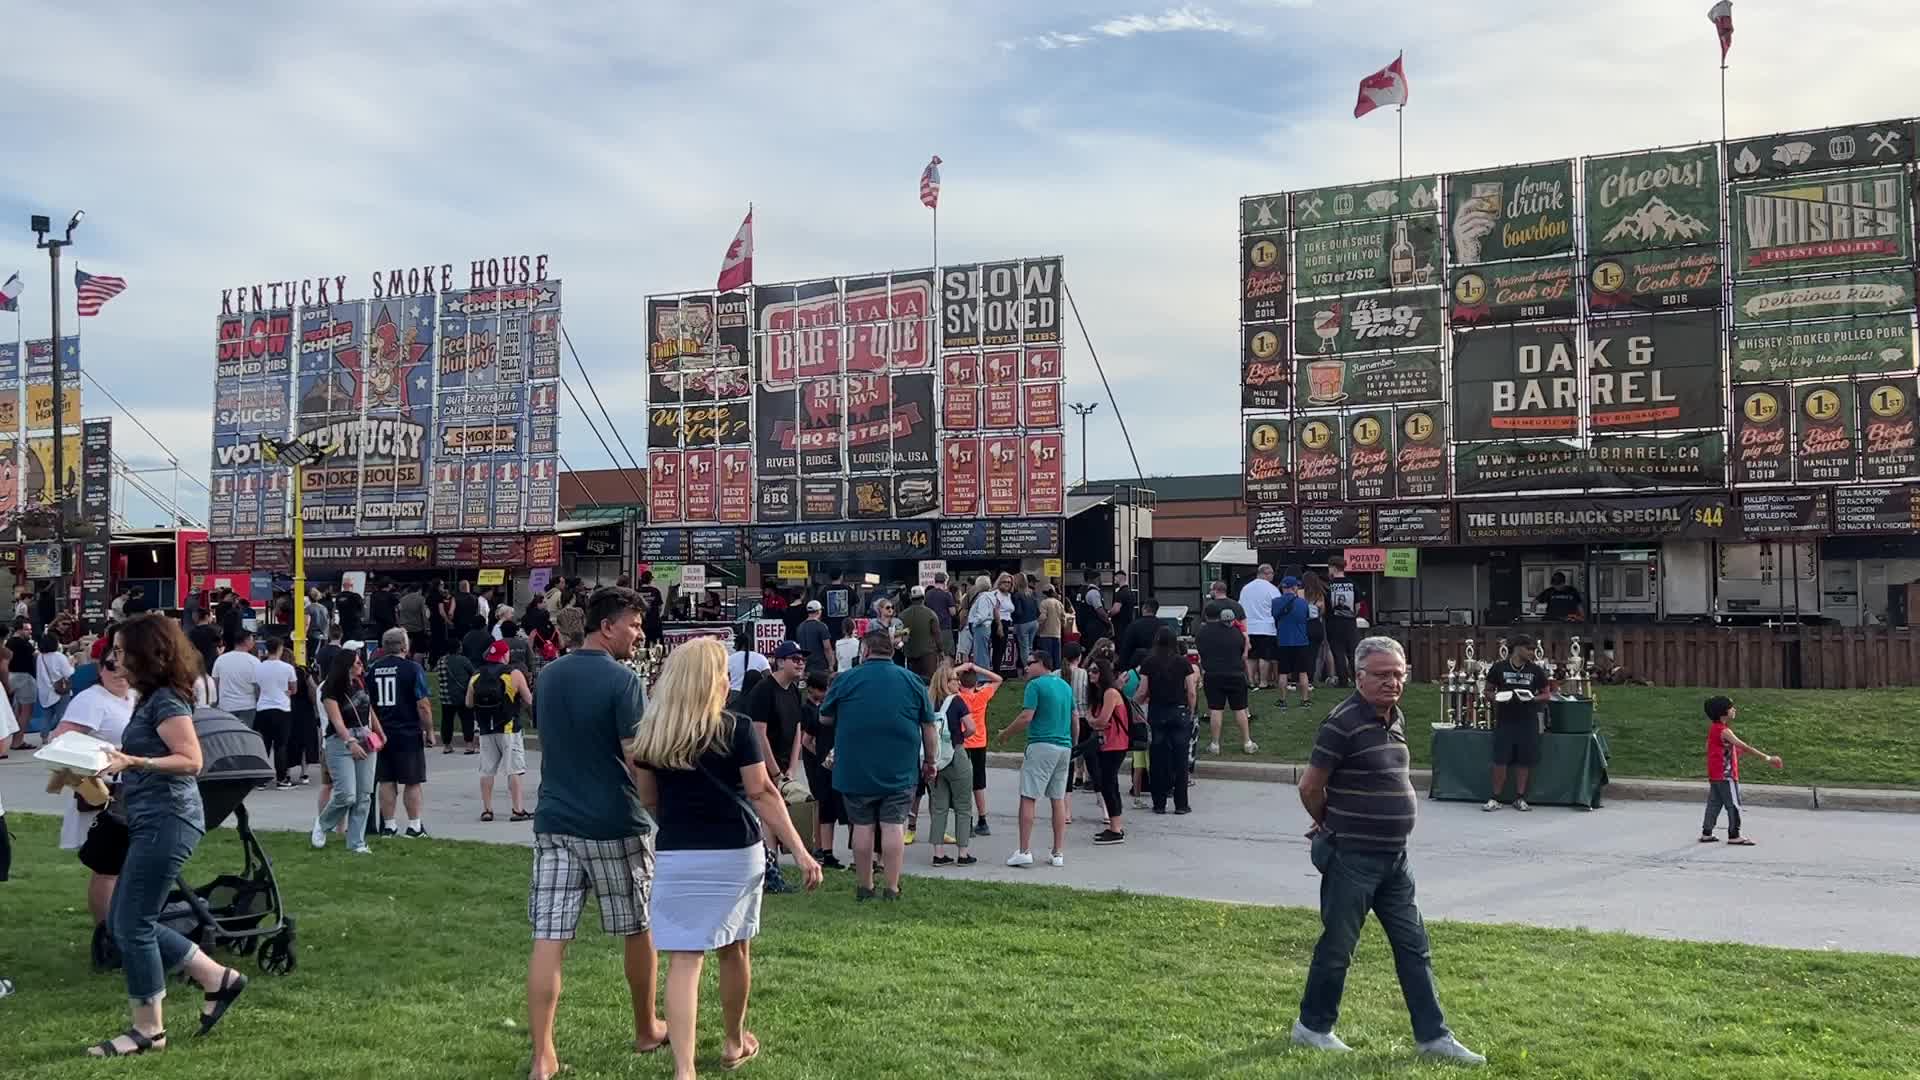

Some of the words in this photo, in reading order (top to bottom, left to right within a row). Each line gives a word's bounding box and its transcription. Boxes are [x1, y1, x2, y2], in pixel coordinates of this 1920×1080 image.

[1600, 160, 1703, 208] Cheers!
[1507, 181, 1564, 219] drink
[1502, 215, 1568, 248] bourbon
[1304, 242, 1327, 253] TAKE
[1330, 239, 1349, 250] OUR
[1351, 234, 1382, 247] SAUCE
[1767, 247, 1814, 260] FINEST
[1818, 241, 1881, 255] QUALITY
[1305, 253, 1333, 267] HOME
[1336, 250, 1359, 263] WITH
[1361, 247, 1382, 260] YOU
[221, 274, 347, 316] KENTUCKY
[372, 263, 453, 299] SMOKE
[470, 253, 550, 290] HOUSE
[944, 264, 1057, 300] SLOW
[1312, 272, 1333, 286] 1/$7
[1346, 267, 1376, 281] 2/$12
[1599, 267, 1620, 287] 1ST
[1636, 271, 1681, 293] Cook
[1685, 265, 1716, 287] off
[1496, 286, 1537, 305] Cook
[1542, 278, 1570, 299] off
[1759, 289, 1841, 310] Delicious
[1847, 285, 1883, 300] Ribs
[462, 298, 538, 313] CHICKEN
[718, 302, 745, 314] VOTE
[1356, 298, 1378, 310] It's
[302, 309, 329, 321] VOTE
[779, 299, 919, 330] LOUISIANA
[946, 297, 1055, 334] SMOKED
[1350, 305, 1414, 326] BBQ
[506, 319, 520, 330] TRY
[1353, 316, 1423, 340] Time!
[219, 316, 290, 362] SLOW
[301, 332, 351, 354] CHOICE
[442, 329, 490, 353] Feeling
[505, 332, 520, 343] OUR
[983, 334, 1017, 344] STYLE
[1024, 332, 1057, 342] RIBS
[1738, 337, 1783, 350] WHISKEY
[1786, 332, 1831, 346] SMOKED
[1834, 328, 1874, 342] PULLED
[1876, 326, 1905, 338] PORK
[1518, 338, 1613, 374] OAK
[1628, 335, 1655, 365] &
[1769, 358, 1788, 371] Get
[1816, 353, 1833, 363] the
[1835, 351, 1874, 364] pound!
[218, 361, 262, 377] SMOKED
[265, 358, 288, 372] RIBS
[1394, 371, 1427, 379] SAUCE
[814, 375, 879, 398] BEST
[1387, 387, 1428, 396] DRINKING
[1492, 370, 1677, 412] BARREL
[814, 399, 828, 409] IN
[834, 390, 880, 408] TOWN
[1751, 398, 1774, 417] 1ST
[1812, 395, 1835, 415] 1ST
[1877, 391, 1901, 411] 1ST
[219, 407, 282, 426] SAUCES
[443, 405, 463, 416] CALL
[859, 420, 903, 440] TEAM
[1308, 426, 1326, 443] 1ST
[1359, 422, 1377, 440] 1ST
[1411, 417, 1430, 436] 1ST
[1740, 427, 1785, 445] Best
[1806, 426, 1844, 443] Best
[1867, 421, 1914, 440] Best
[301, 419, 424, 459] KENTUCKY
[455, 429, 509, 444] SMOKED
[1867, 436, 1916, 453] chicken
[1801, 438, 1850, 456] Sauce
[766, 456, 796, 468] RIVER
[907, 451, 929, 462] USA
[1352, 449, 1387, 467] Best
[1803, 458, 1849, 467] HAMILTON
[1868, 455, 1915, 464] HAMILTON
[306, 470, 358, 487] SMOKE
[363, 467, 416, 484] HOUSE
[1031, 472, 1056, 480] BEST
[1479, 470, 1507, 480] FROM
[1588, 465, 1635, 474] BRITISH
[1639, 464, 1700, 474] COLUMBIA
[991, 488, 1013, 497] RIBS
[1030, 487, 1057, 495] SAUCE
[1356, 479, 1384, 487] MILTON
[763, 493, 789, 505] BBQ
[365, 501, 423, 518] KENTUCKY
[1467, 513, 1496, 527] THE
[1501, 510, 1607, 526] LUMBERJACK
[1612, 508, 1681, 523] SPECIAL
[1695, 507, 1724, 528] $44
[783, 532, 808, 545] THE
[810, 530, 847, 544] BELLY
[850, 528, 901, 542] BUSTER
[906, 530, 928, 548] $44
[356, 544, 405, 557] PLATTER
[1349, 554, 1380, 563] POTATO
[756, 623, 785, 638] BEEF
[375, 677, 396, 706] 10
